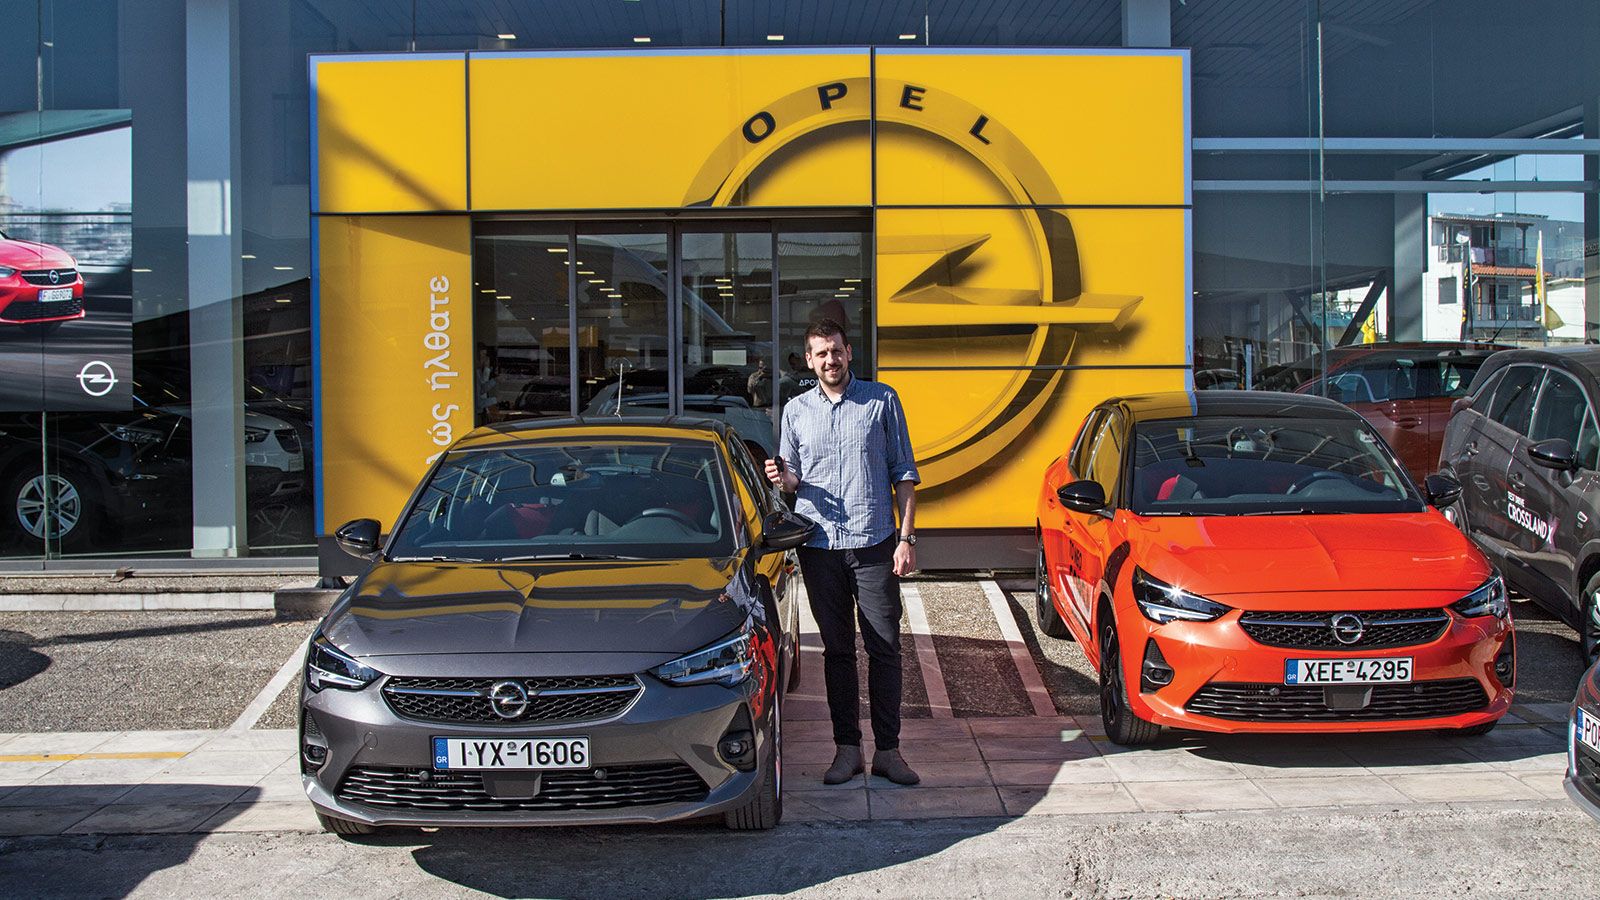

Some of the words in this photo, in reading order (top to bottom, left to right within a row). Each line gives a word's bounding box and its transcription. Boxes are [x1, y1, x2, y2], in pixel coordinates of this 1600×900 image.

[742, 82, 992, 146] OPEL
[424, 275, 459, 391] ήλθατε
[1507, 503, 1547, 539] CROSSLAND
[1585, 717, 1600, 749] PO
[436, 755, 448, 764] GR
